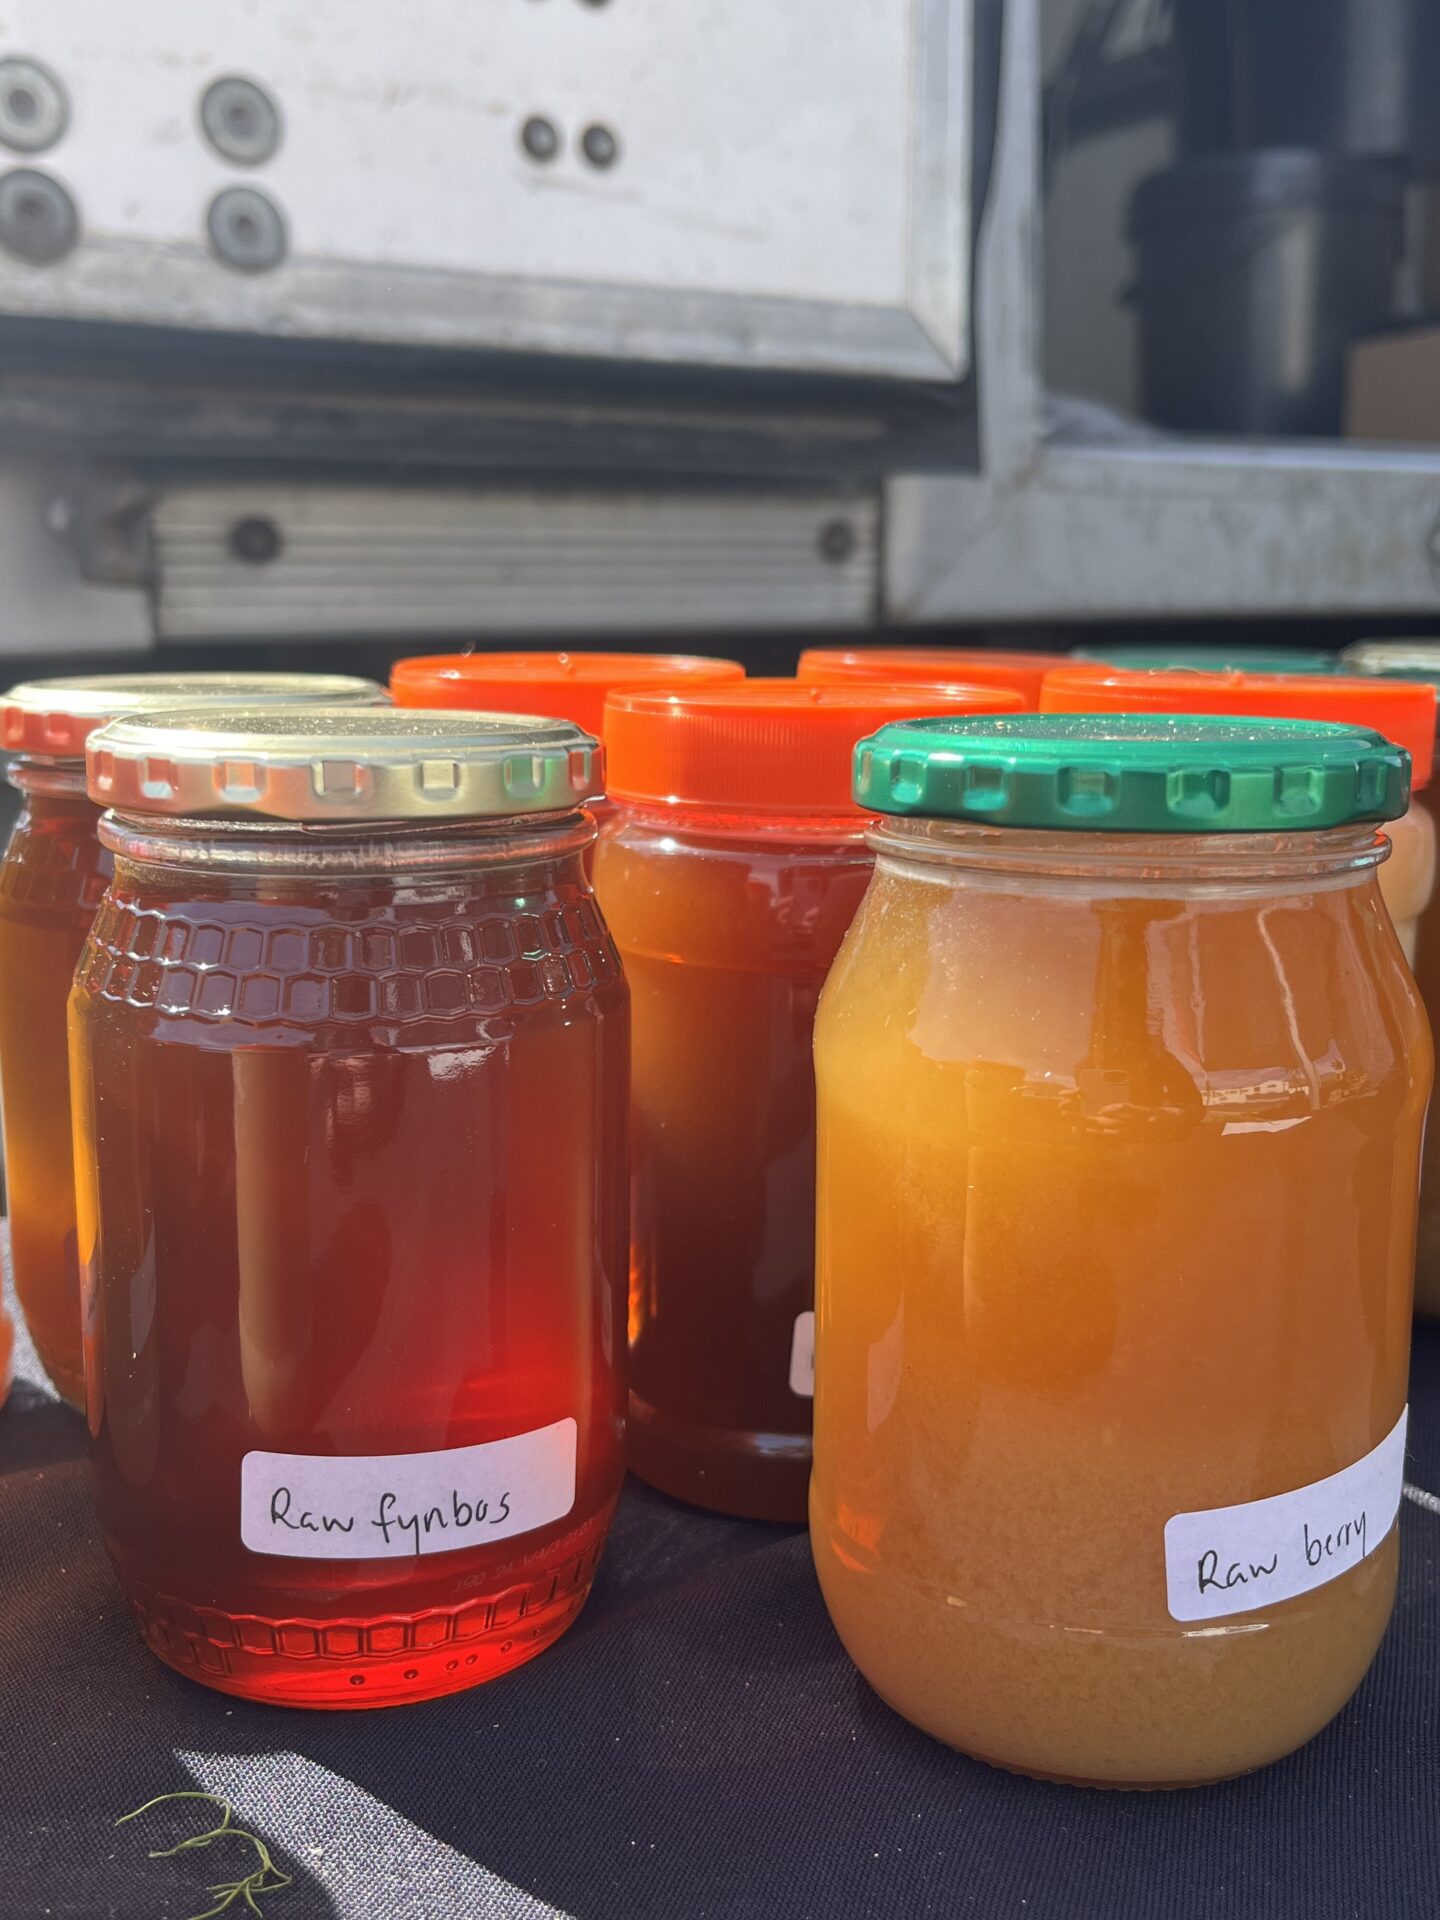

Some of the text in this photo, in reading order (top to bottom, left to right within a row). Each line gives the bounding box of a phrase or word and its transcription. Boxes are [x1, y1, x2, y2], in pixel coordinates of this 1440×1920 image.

[270, 1487, 354, 1532] Raw
[371, 1490, 511, 1555] fynbos
[1197, 1511, 1366, 1594] Raw berry
